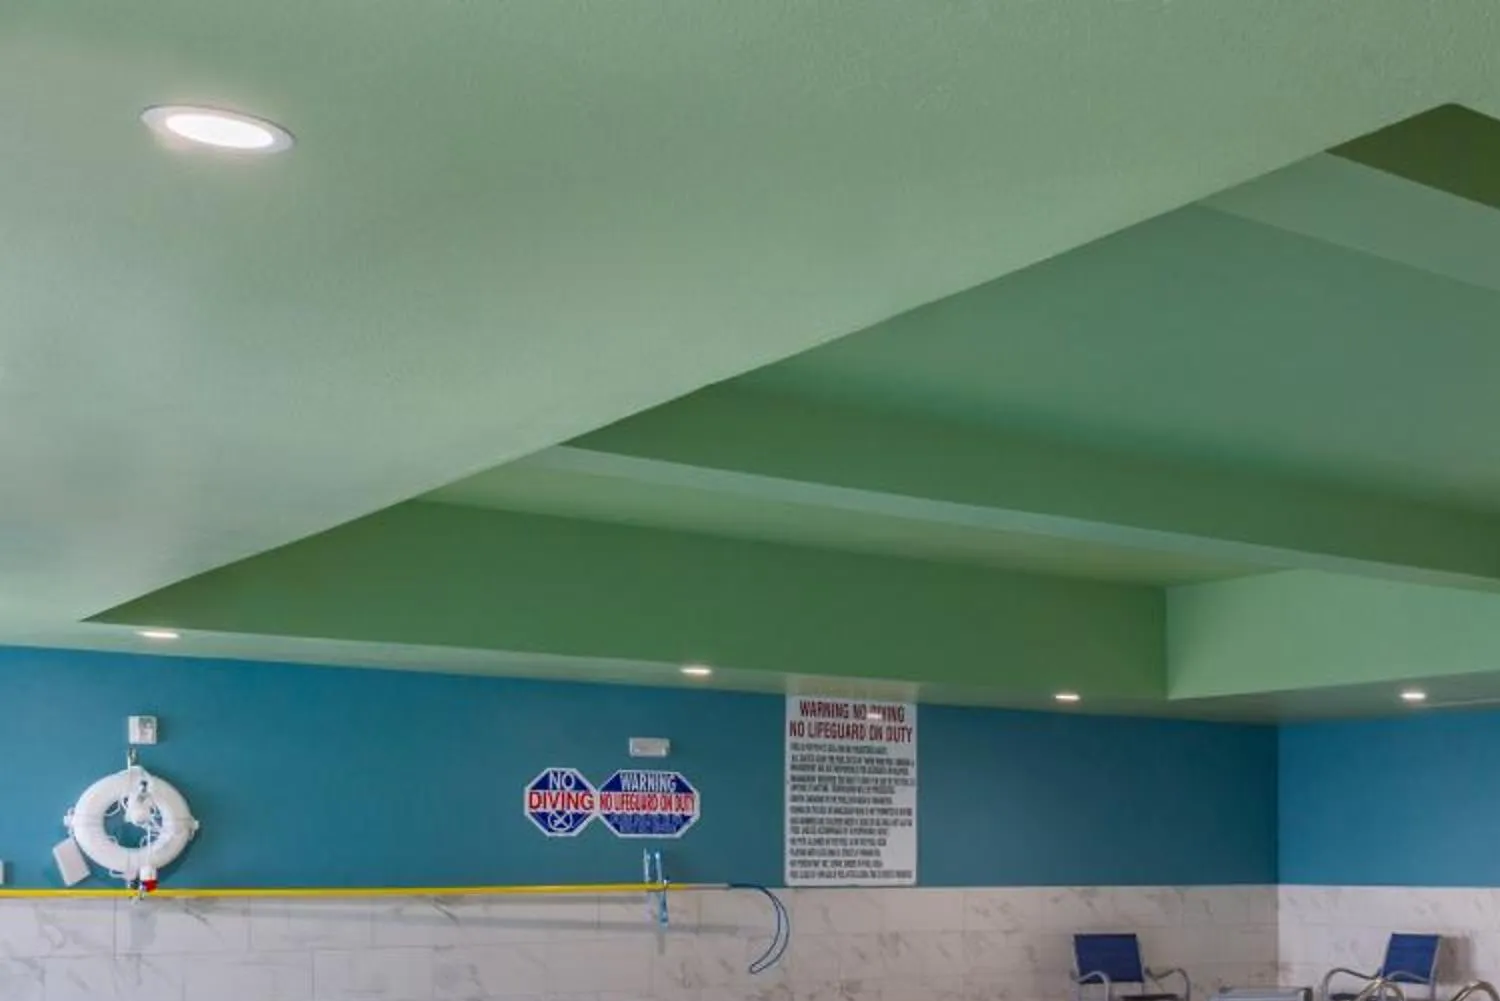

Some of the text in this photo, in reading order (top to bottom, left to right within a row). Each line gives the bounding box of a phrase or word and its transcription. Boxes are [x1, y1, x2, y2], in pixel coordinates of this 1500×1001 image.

[799, 700, 849, 719] WARNING
[853, 703, 867, 720] NO
[789, 720, 913, 744] NO LIFEGUARD ON DUTY
[549, 770, 575, 790] NO
[620, 772, 677, 792] WARNING
[529, 791, 594, 810] DIVING
[600, 791, 612, 810] NO
